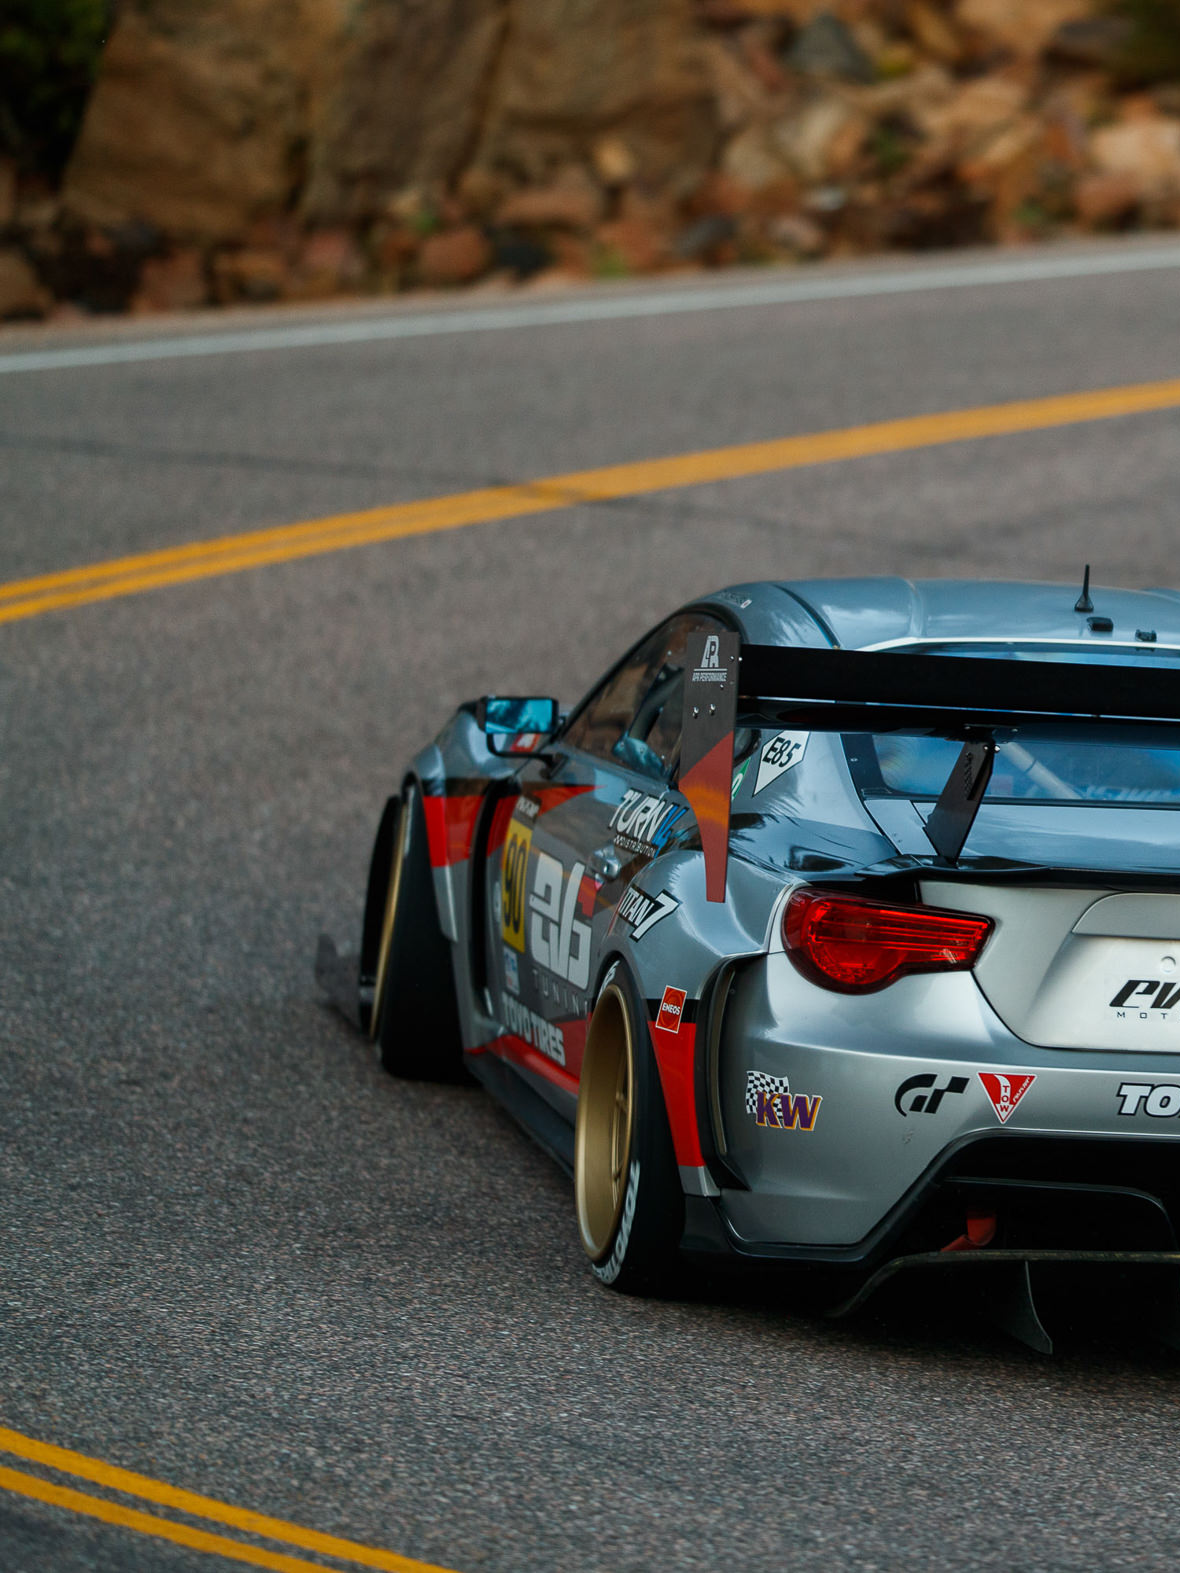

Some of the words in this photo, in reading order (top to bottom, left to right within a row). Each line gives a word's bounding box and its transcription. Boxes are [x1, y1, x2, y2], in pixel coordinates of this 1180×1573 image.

[762, 736, 802, 768] E85
[504, 832, 528, 935] 90
[661, 1002, 681, 1016] ENEOS
[530, 1011, 567, 1068] TIRES
[755, 1090, 824, 1132] KW
[1000, 1085, 1011, 1113] TOW
